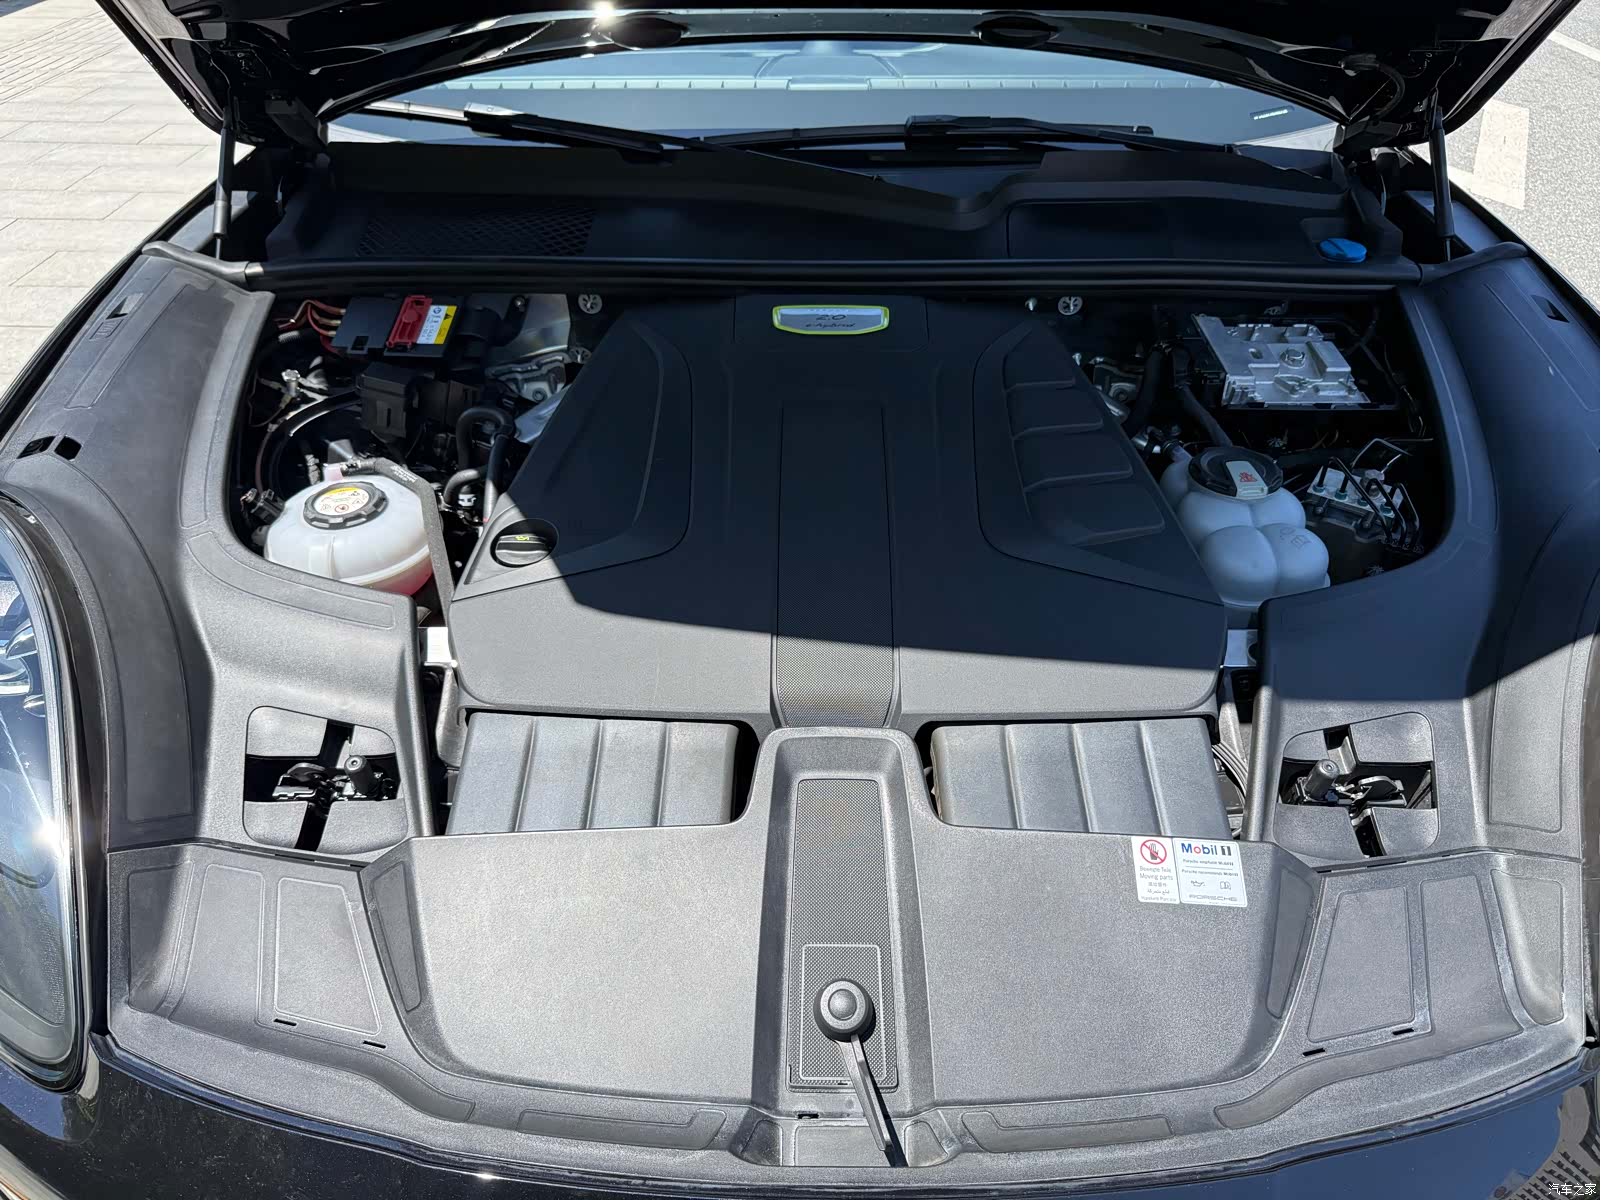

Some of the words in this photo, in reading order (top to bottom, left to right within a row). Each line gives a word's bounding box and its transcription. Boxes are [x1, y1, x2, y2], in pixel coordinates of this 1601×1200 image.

[1181, 843, 1218, 855] Mobil
[1220, 846, 1232, 856] 1
[1139, 872, 1159, 881] Moving
[1189, 894, 1238, 902] PORSCHE
